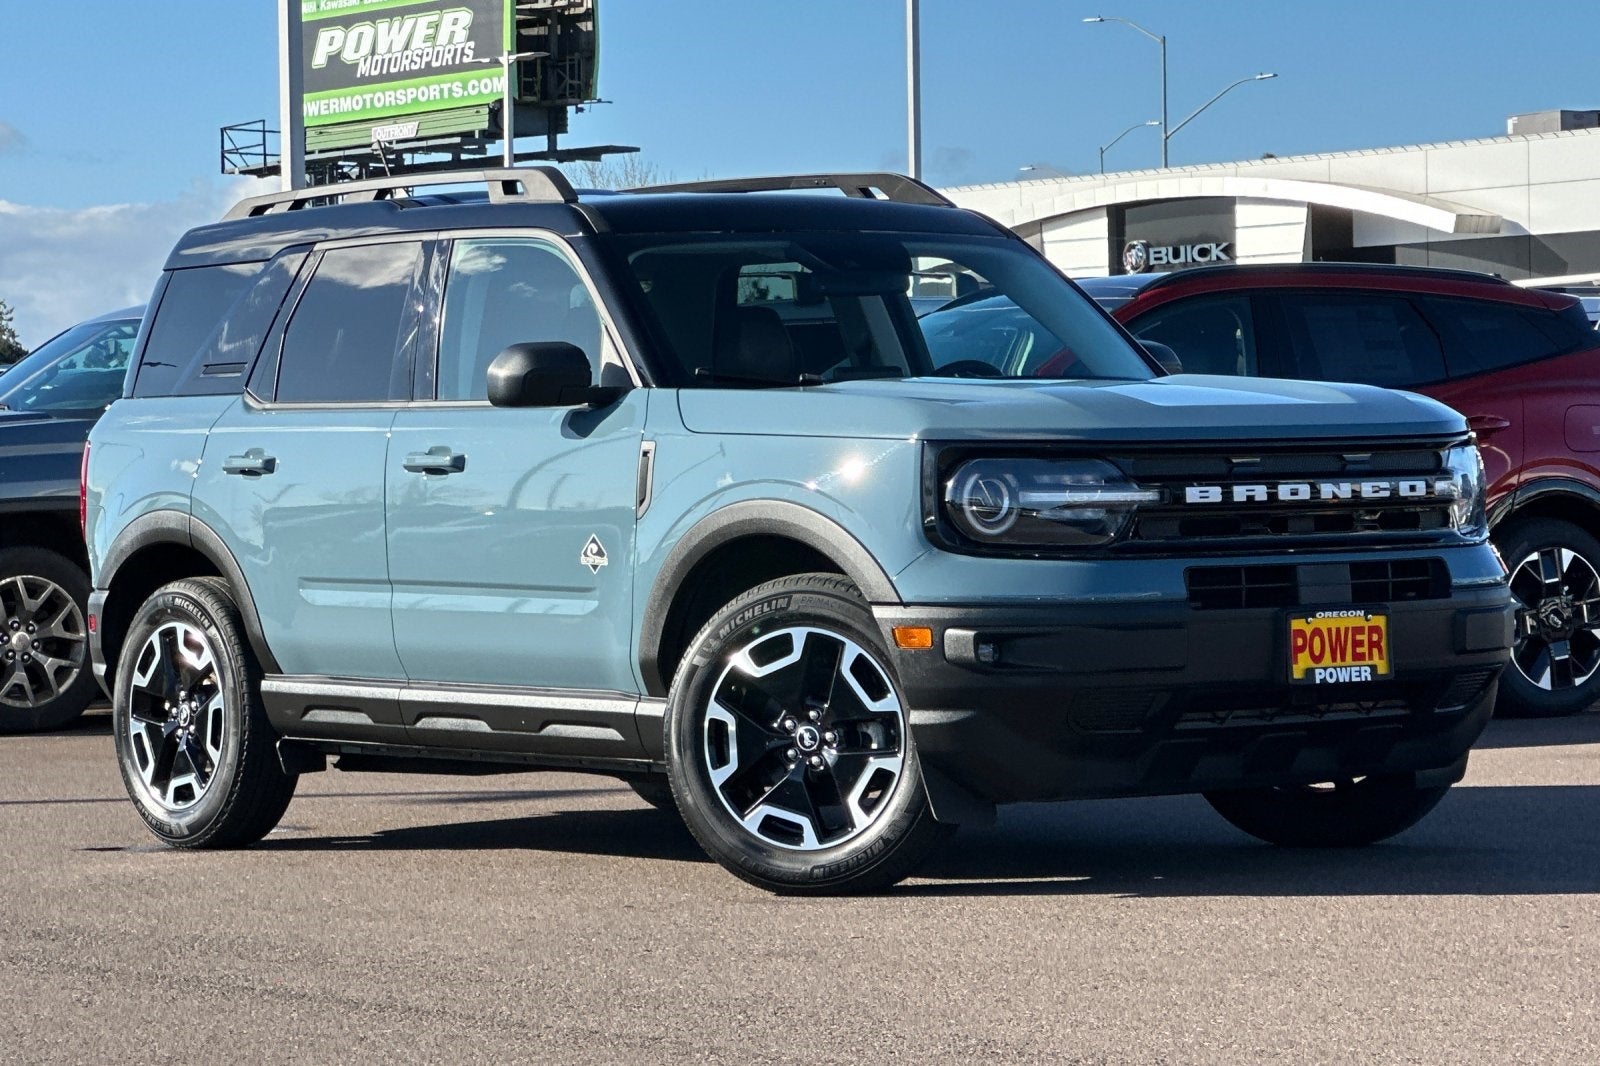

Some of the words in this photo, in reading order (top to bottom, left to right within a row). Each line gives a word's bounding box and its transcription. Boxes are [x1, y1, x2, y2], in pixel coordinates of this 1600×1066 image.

[312, 7, 474, 69] POWER
[357, 41, 476, 78] MOTORSPORTS
[303, 76, 505, 117] WERMOTORSPORTS.COM
[1149, 242, 1231, 265] BUICK
[1185, 480, 1427, 503] BRONCO
[175, 597, 211, 628] MICHELIN
[719, 597, 789, 640] MICHELIN
[1315, 610, 1365, 618] OREGON
[1292, 625, 1385, 665] POWER
[1315, 666, 1371, 684] POWER
